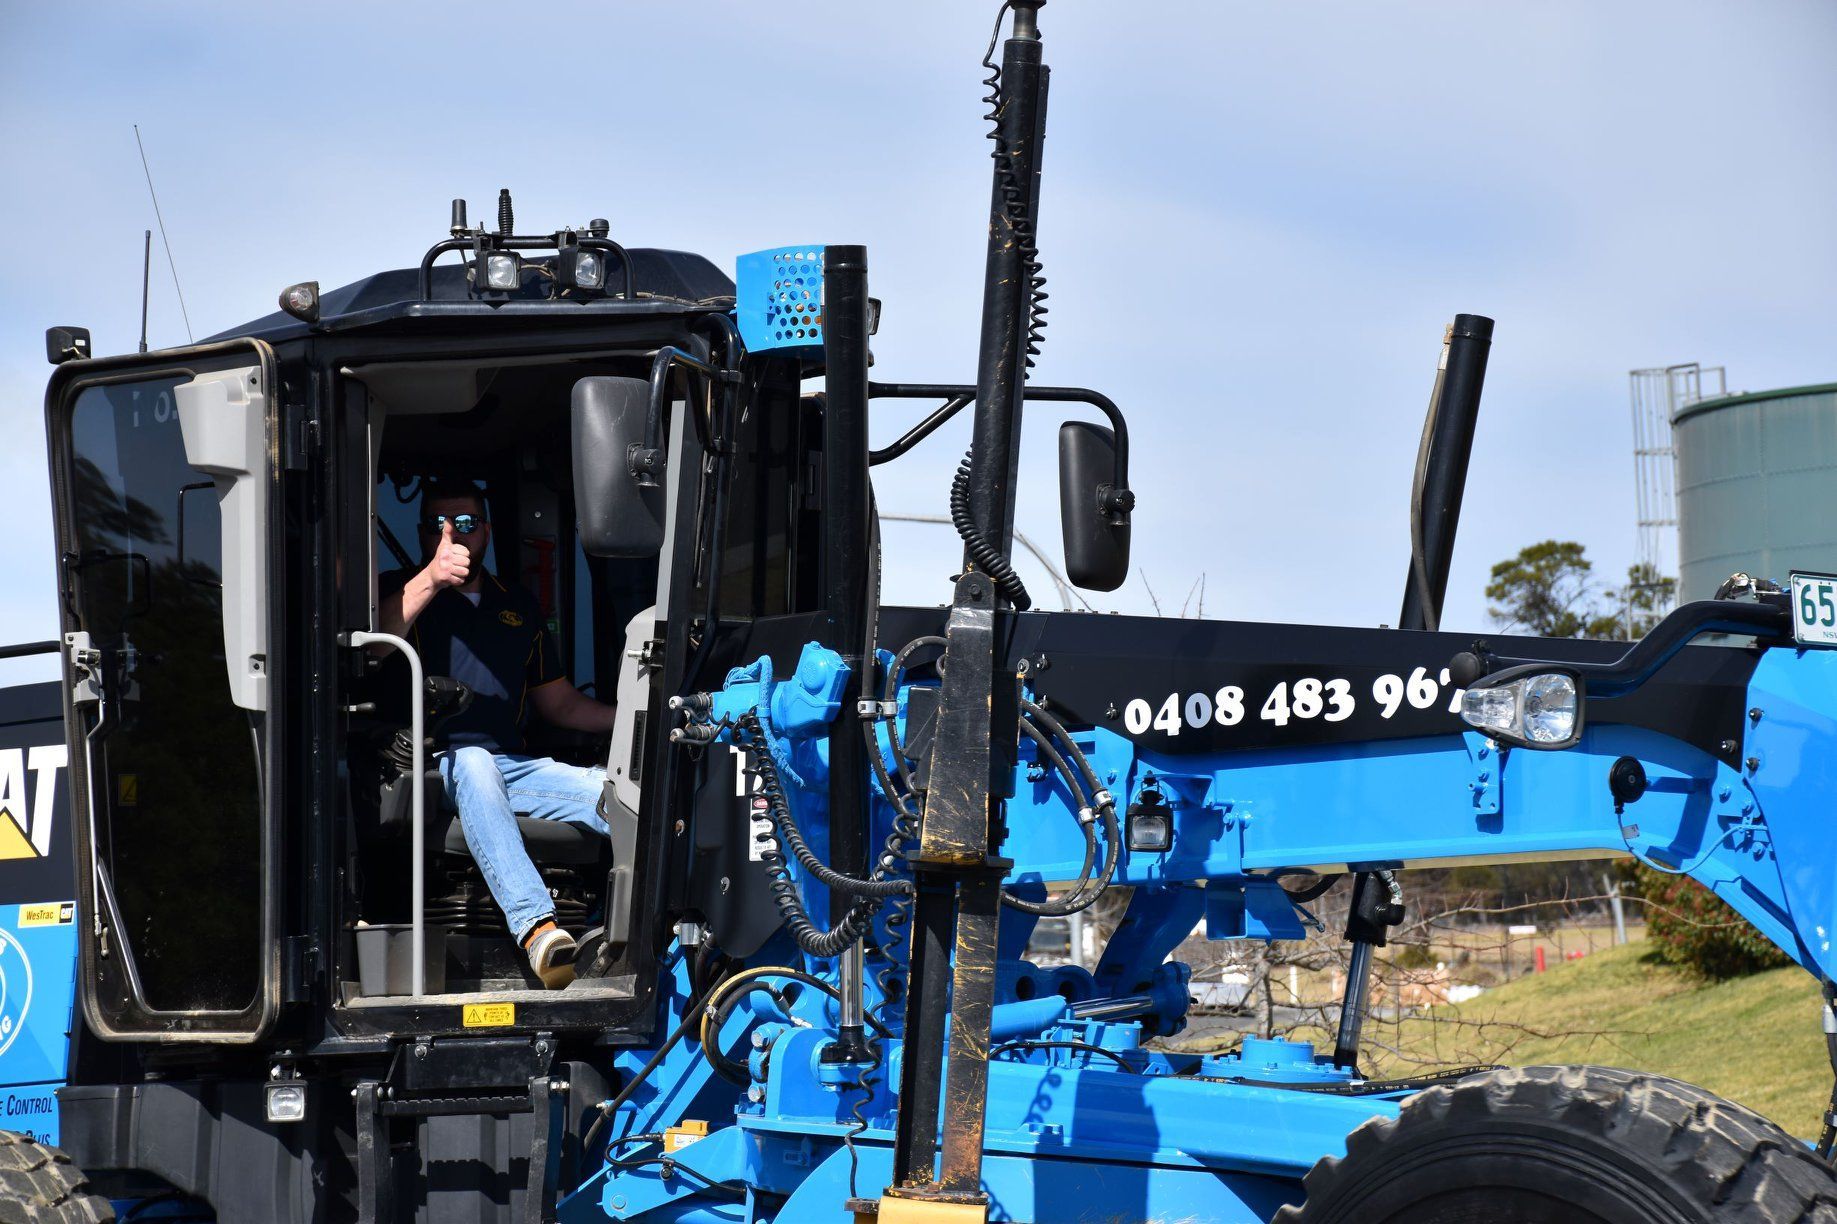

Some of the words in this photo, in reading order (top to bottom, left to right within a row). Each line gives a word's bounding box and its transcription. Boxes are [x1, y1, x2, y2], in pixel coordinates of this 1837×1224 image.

[1124, 685, 1245, 736] 0408
[1260, 677, 1356, 727] 483
[26, 909, 54, 921] WesTrac
